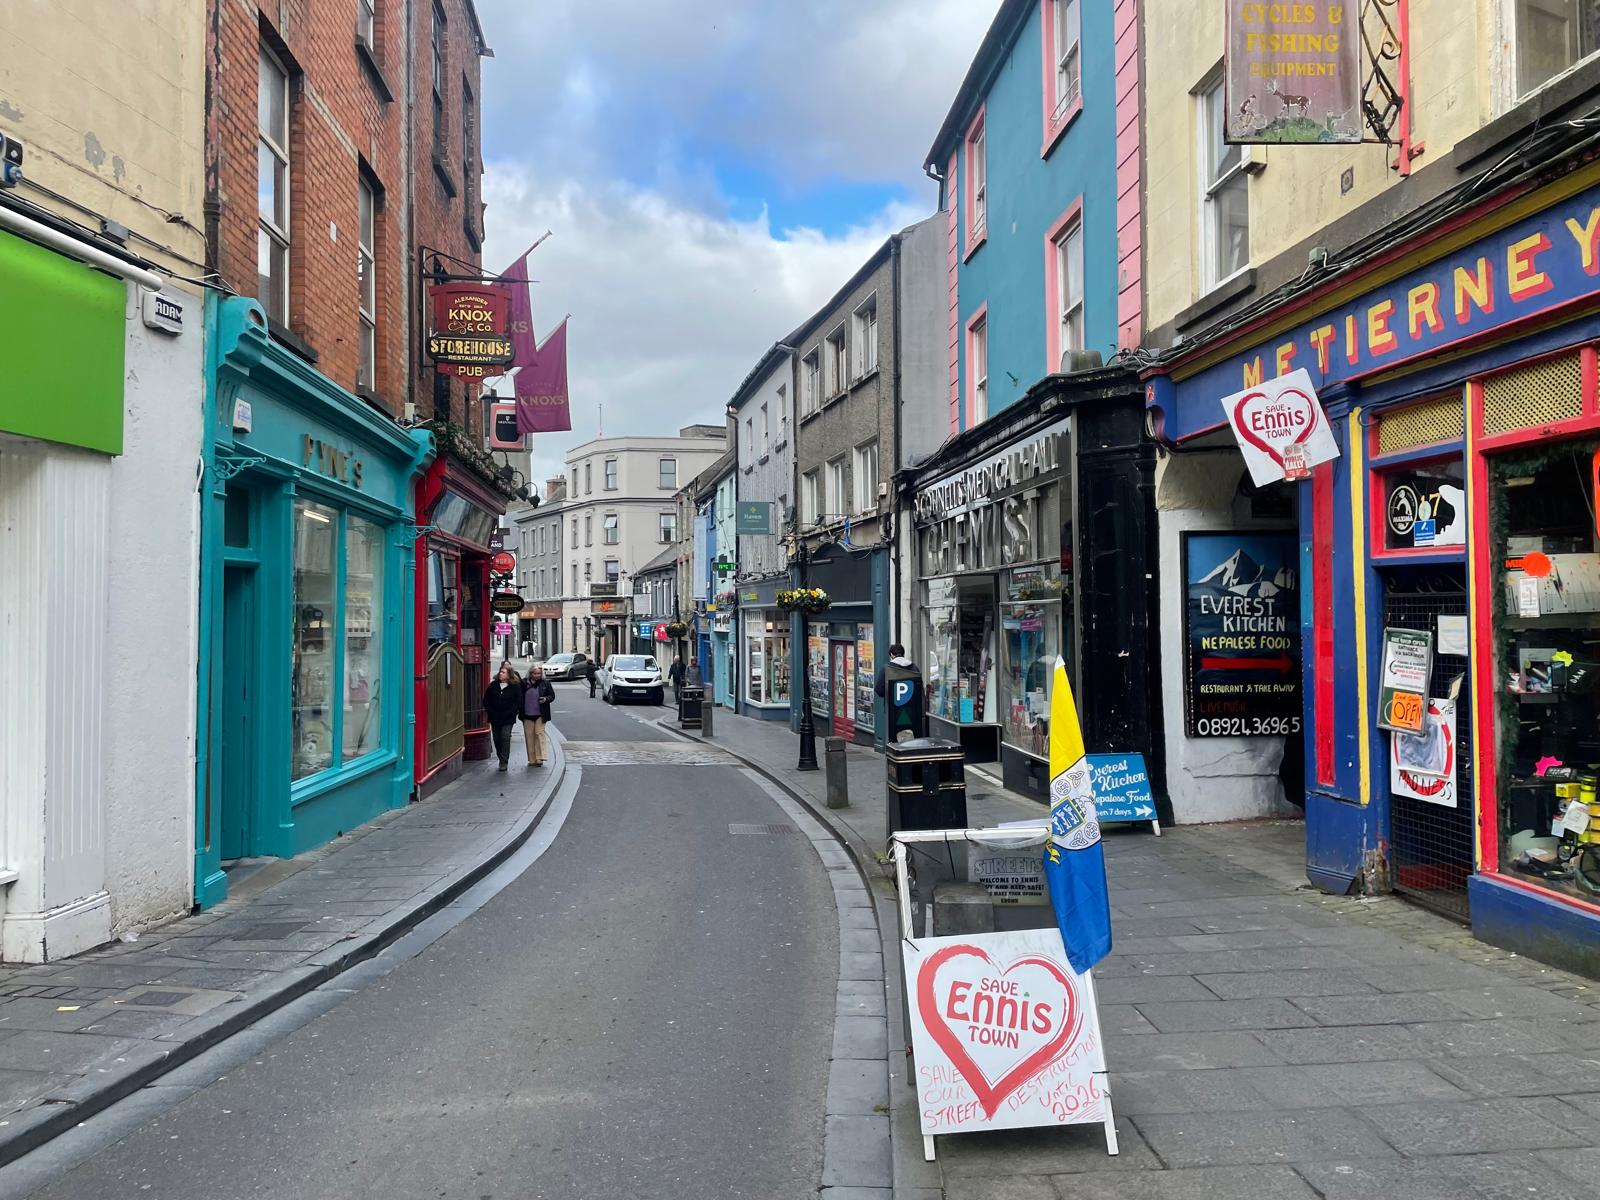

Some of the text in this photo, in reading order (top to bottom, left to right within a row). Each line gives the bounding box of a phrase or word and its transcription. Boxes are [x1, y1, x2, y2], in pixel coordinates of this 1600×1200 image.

[1242, 3, 1343, 24] CYCLES &
[1246, 33, 1340, 53] FISHING
[1249, 62, 1337, 79] EQUIPMENT
[454, 296, 489, 306] ALEXANDER
[448, 309, 493, 322] KNOX
[430, 339, 511, 356] STOREHOUSE
[458, 366, 483, 376] PUB
[519, 395, 566, 407] KNOXS
[1265, 403, 1286, 413] SAVE
[1265, 428, 1292, 439] TOWN
[926, 487, 1041, 575] CHEMIST
[1200, 595, 1276, 617] EVEREST
[1223, 616, 1286, 633] KITCHEN
[1202, 636, 1291, 650] NEPALESE FOOD
[896, 682, 909, 701] P
[1200, 684, 1244, 694] RESTAURANT
[1253, 684, 1272, 693] TAKE
[1273, 684, 1296, 693] AWAY
[1097, 772, 1147, 792] Kitchen
[1126, 788, 1152, 805] Food
[1114, 808, 1132, 817] days
[974, 856, 1044, 875] STREETS
[979, 877, 1010, 885] WELCOME
[980, 977, 1019, 997] SAVE
[968, 1025, 1020, 1049] TOWN
[920, 1064, 965, 1088] SAVE
[1007, 1030, 1097, 1112] DESTRUCTION
[924, 1086, 967, 1104] OUR
[1052, 1074, 1101, 1122] 2026
[923, 1099, 991, 1129] STREETS
